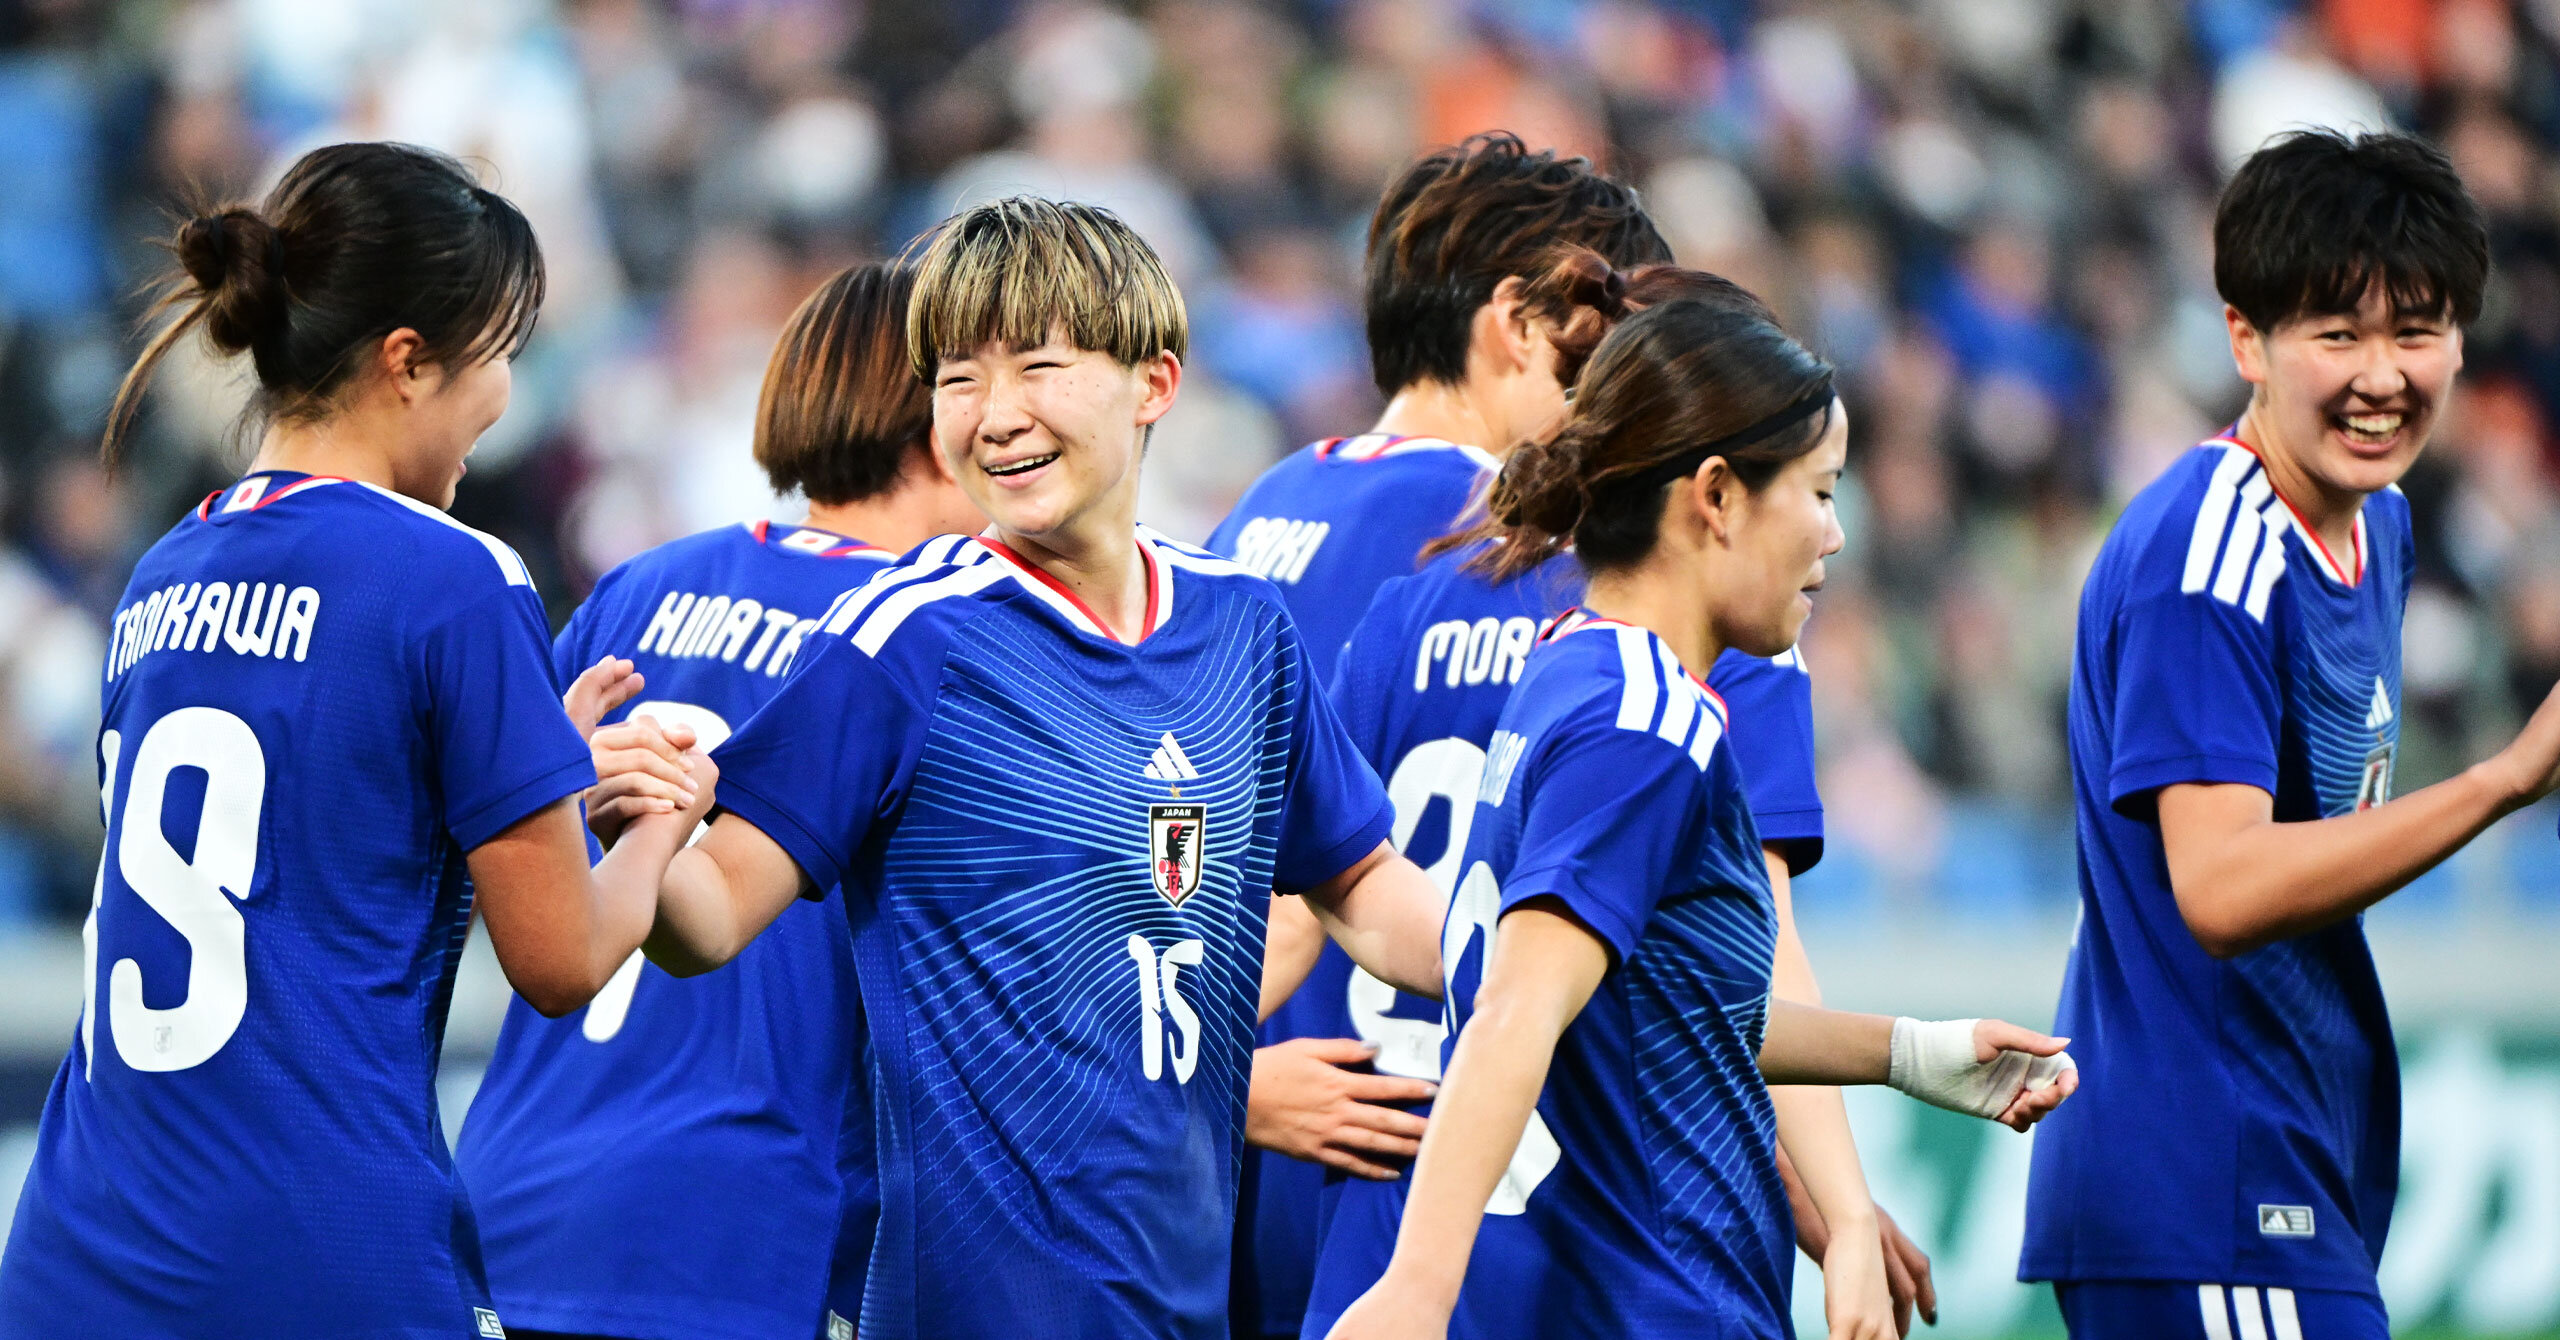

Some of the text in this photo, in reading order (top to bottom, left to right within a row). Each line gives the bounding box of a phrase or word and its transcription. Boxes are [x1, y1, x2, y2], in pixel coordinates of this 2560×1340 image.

[107, 581, 321, 683] TANIKAWA
[1415, 616, 1555, 693] MOR
[1162, 808, 1191, 816] JAPAN
[1165, 876, 1184, 890] JFA
[1128, 934, 1203, 1084] 15
